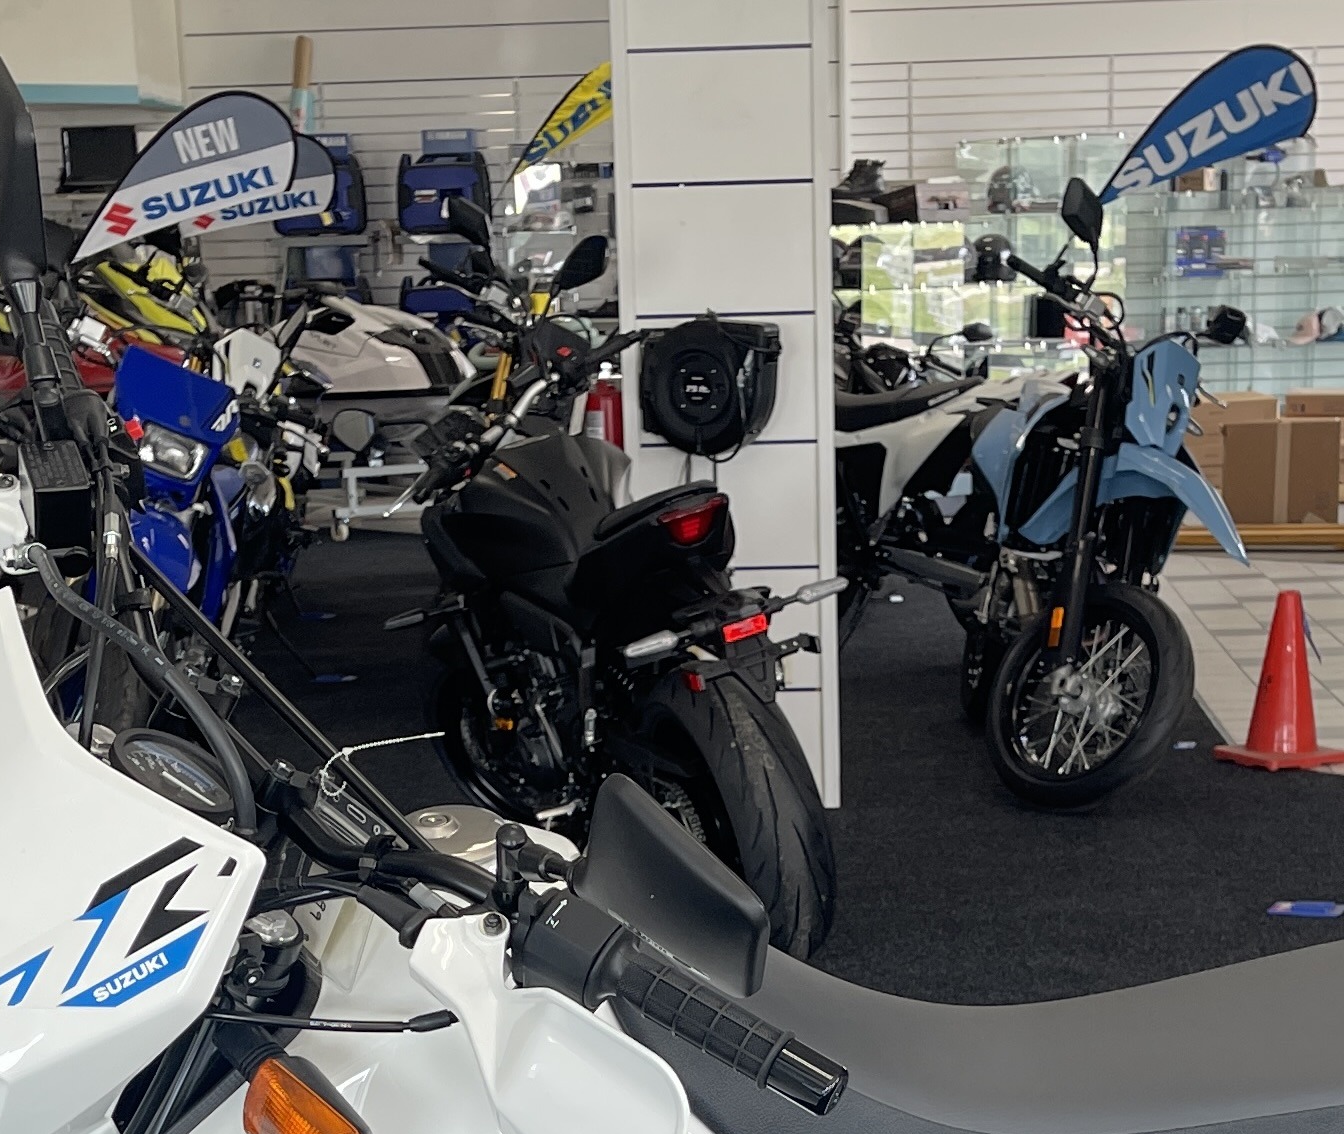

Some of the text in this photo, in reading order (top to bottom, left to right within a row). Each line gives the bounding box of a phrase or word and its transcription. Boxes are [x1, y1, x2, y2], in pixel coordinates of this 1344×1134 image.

[172, 116, 240, 164] NEW
[1113, 60, 1314, 191] SUZUKI
[141, 165, 278, 221] SUZUKI
[220, 190, 319, 221] SUZUKI
[93, 952, 170, 1004] SUZUKI
